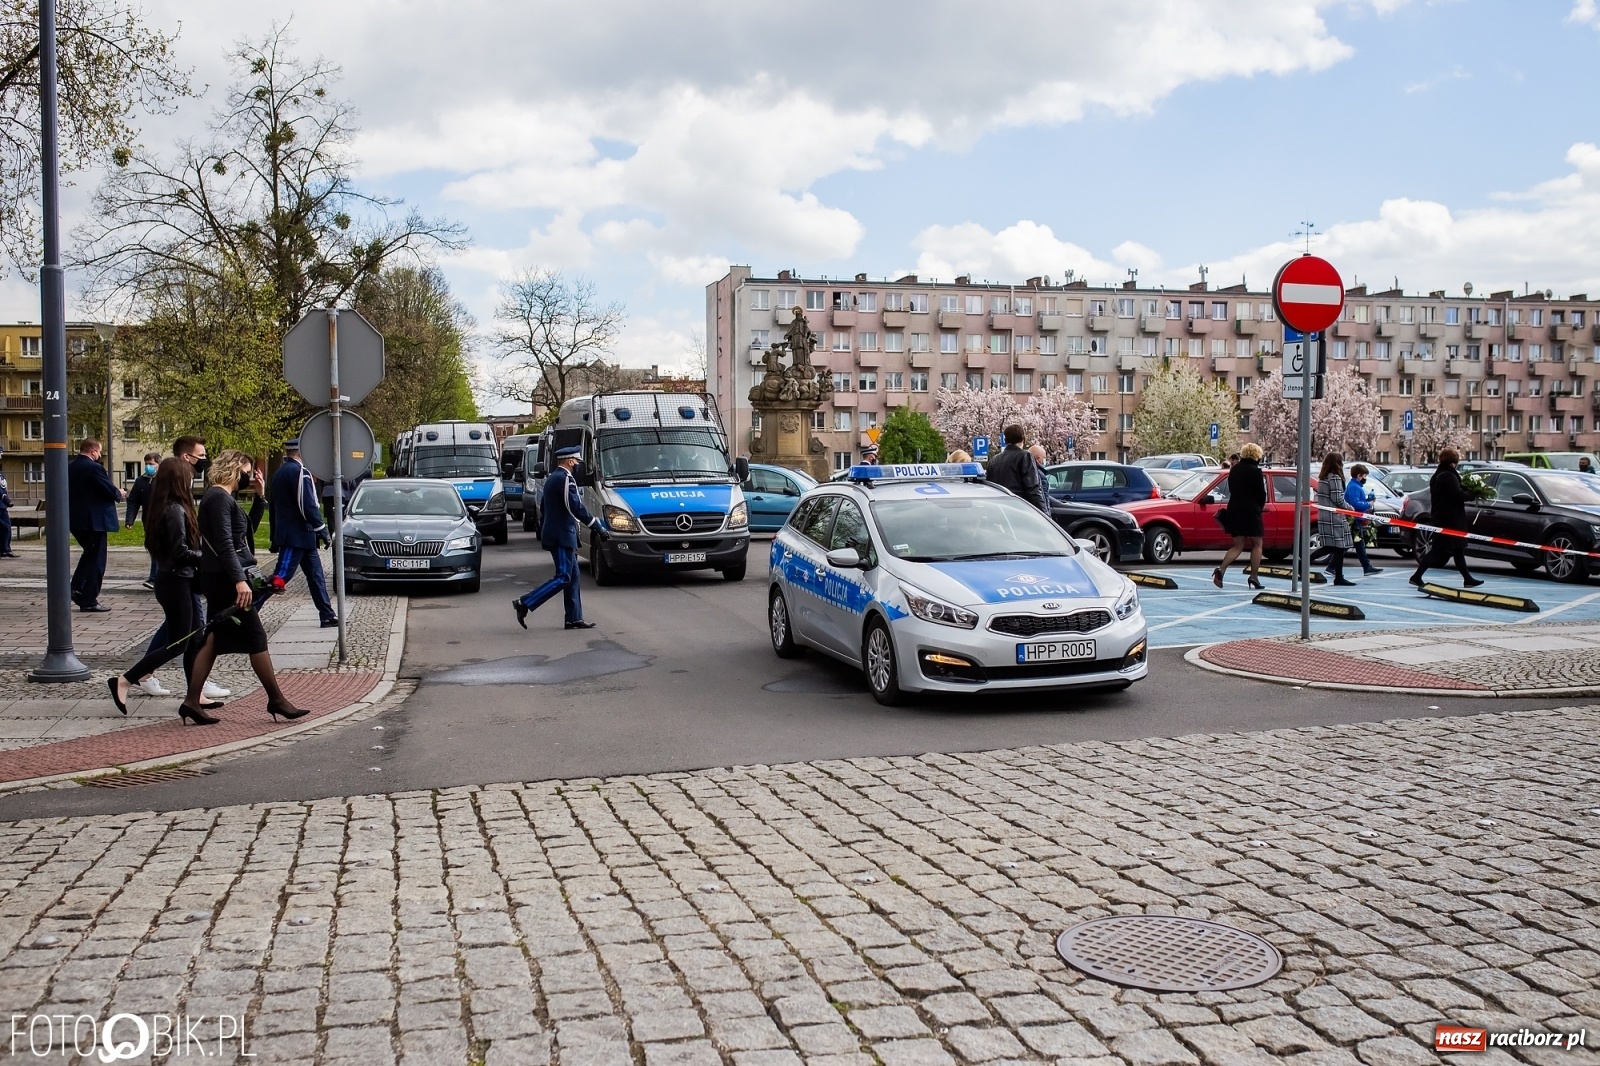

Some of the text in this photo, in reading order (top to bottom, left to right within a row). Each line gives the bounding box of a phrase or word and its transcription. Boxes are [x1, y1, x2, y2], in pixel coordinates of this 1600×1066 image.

[46, 390, 60, 400] 2.4
[1406, 412, 1412, 428] P
[1211, 424, 1217, 437] P
[976, 438, 986, 451] P
[895, 465, 938, 477] POLICJA
[651, 490, 706, 499] POLICJA
[391, 559, 428, 568] SRC 11F1
[669, 553, 705, 562] HPP E152
[824, 577, 848, 602] POLICJA
[996, 584, 1080, 598] POLICJA
[1026, 644, 1057, 659] HPP
[1061, 642, 1093, 658] R005
